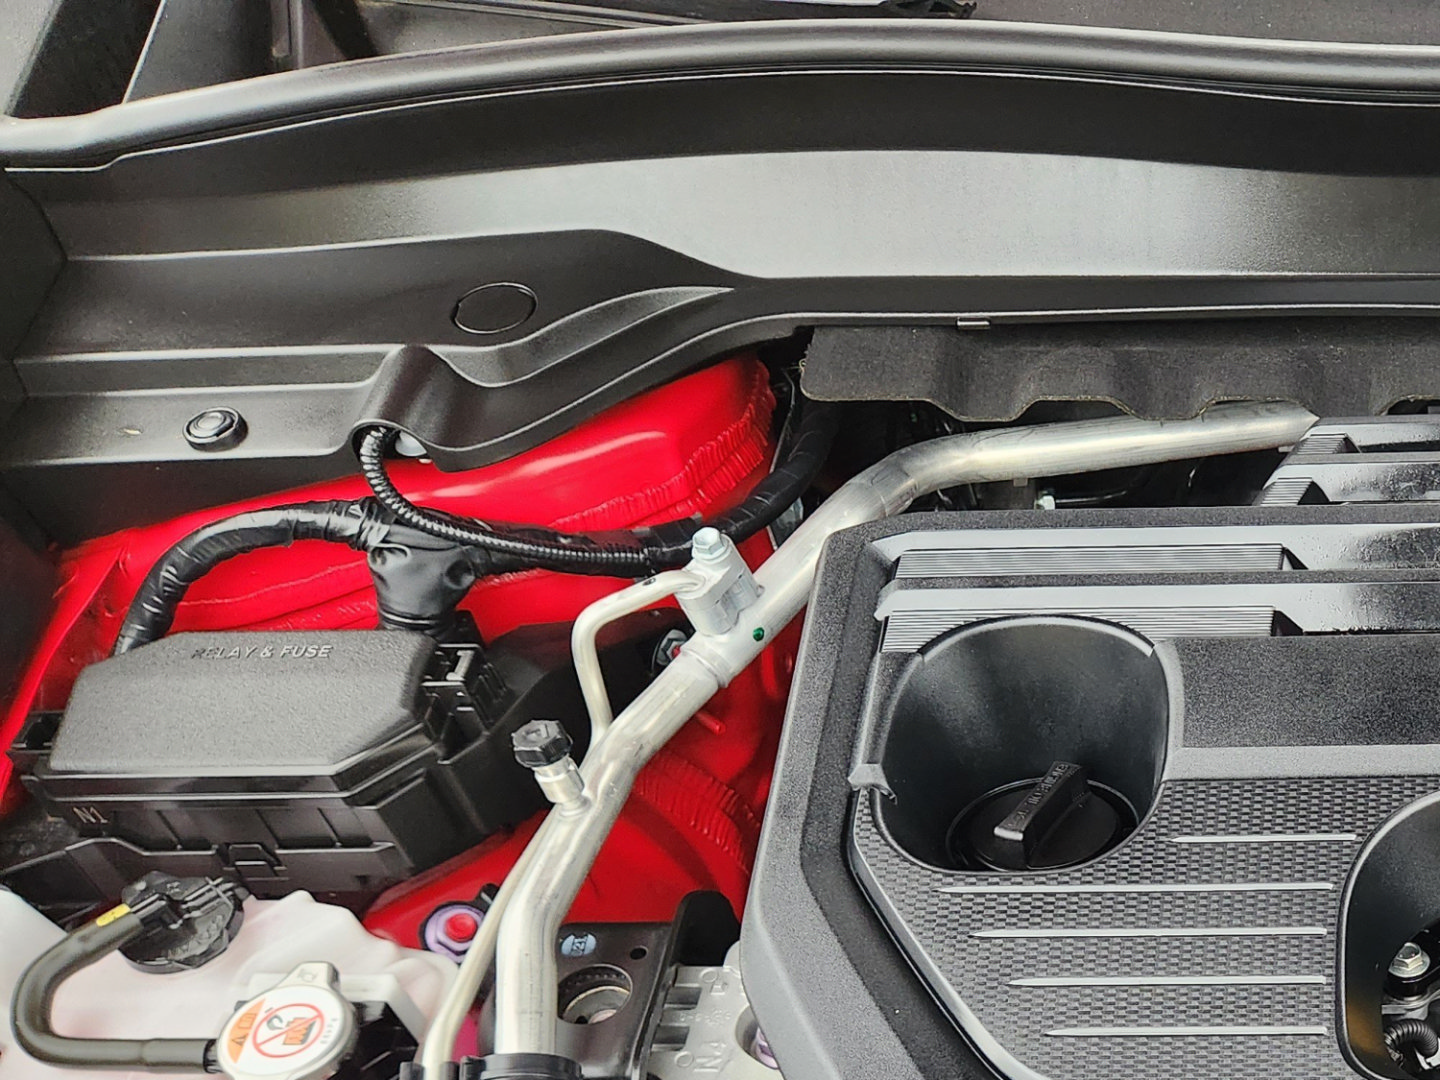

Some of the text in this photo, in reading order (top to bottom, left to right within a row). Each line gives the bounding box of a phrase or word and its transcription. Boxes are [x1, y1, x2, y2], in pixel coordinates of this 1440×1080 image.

[191, 644, 333, 660] RELAY & FUSE
